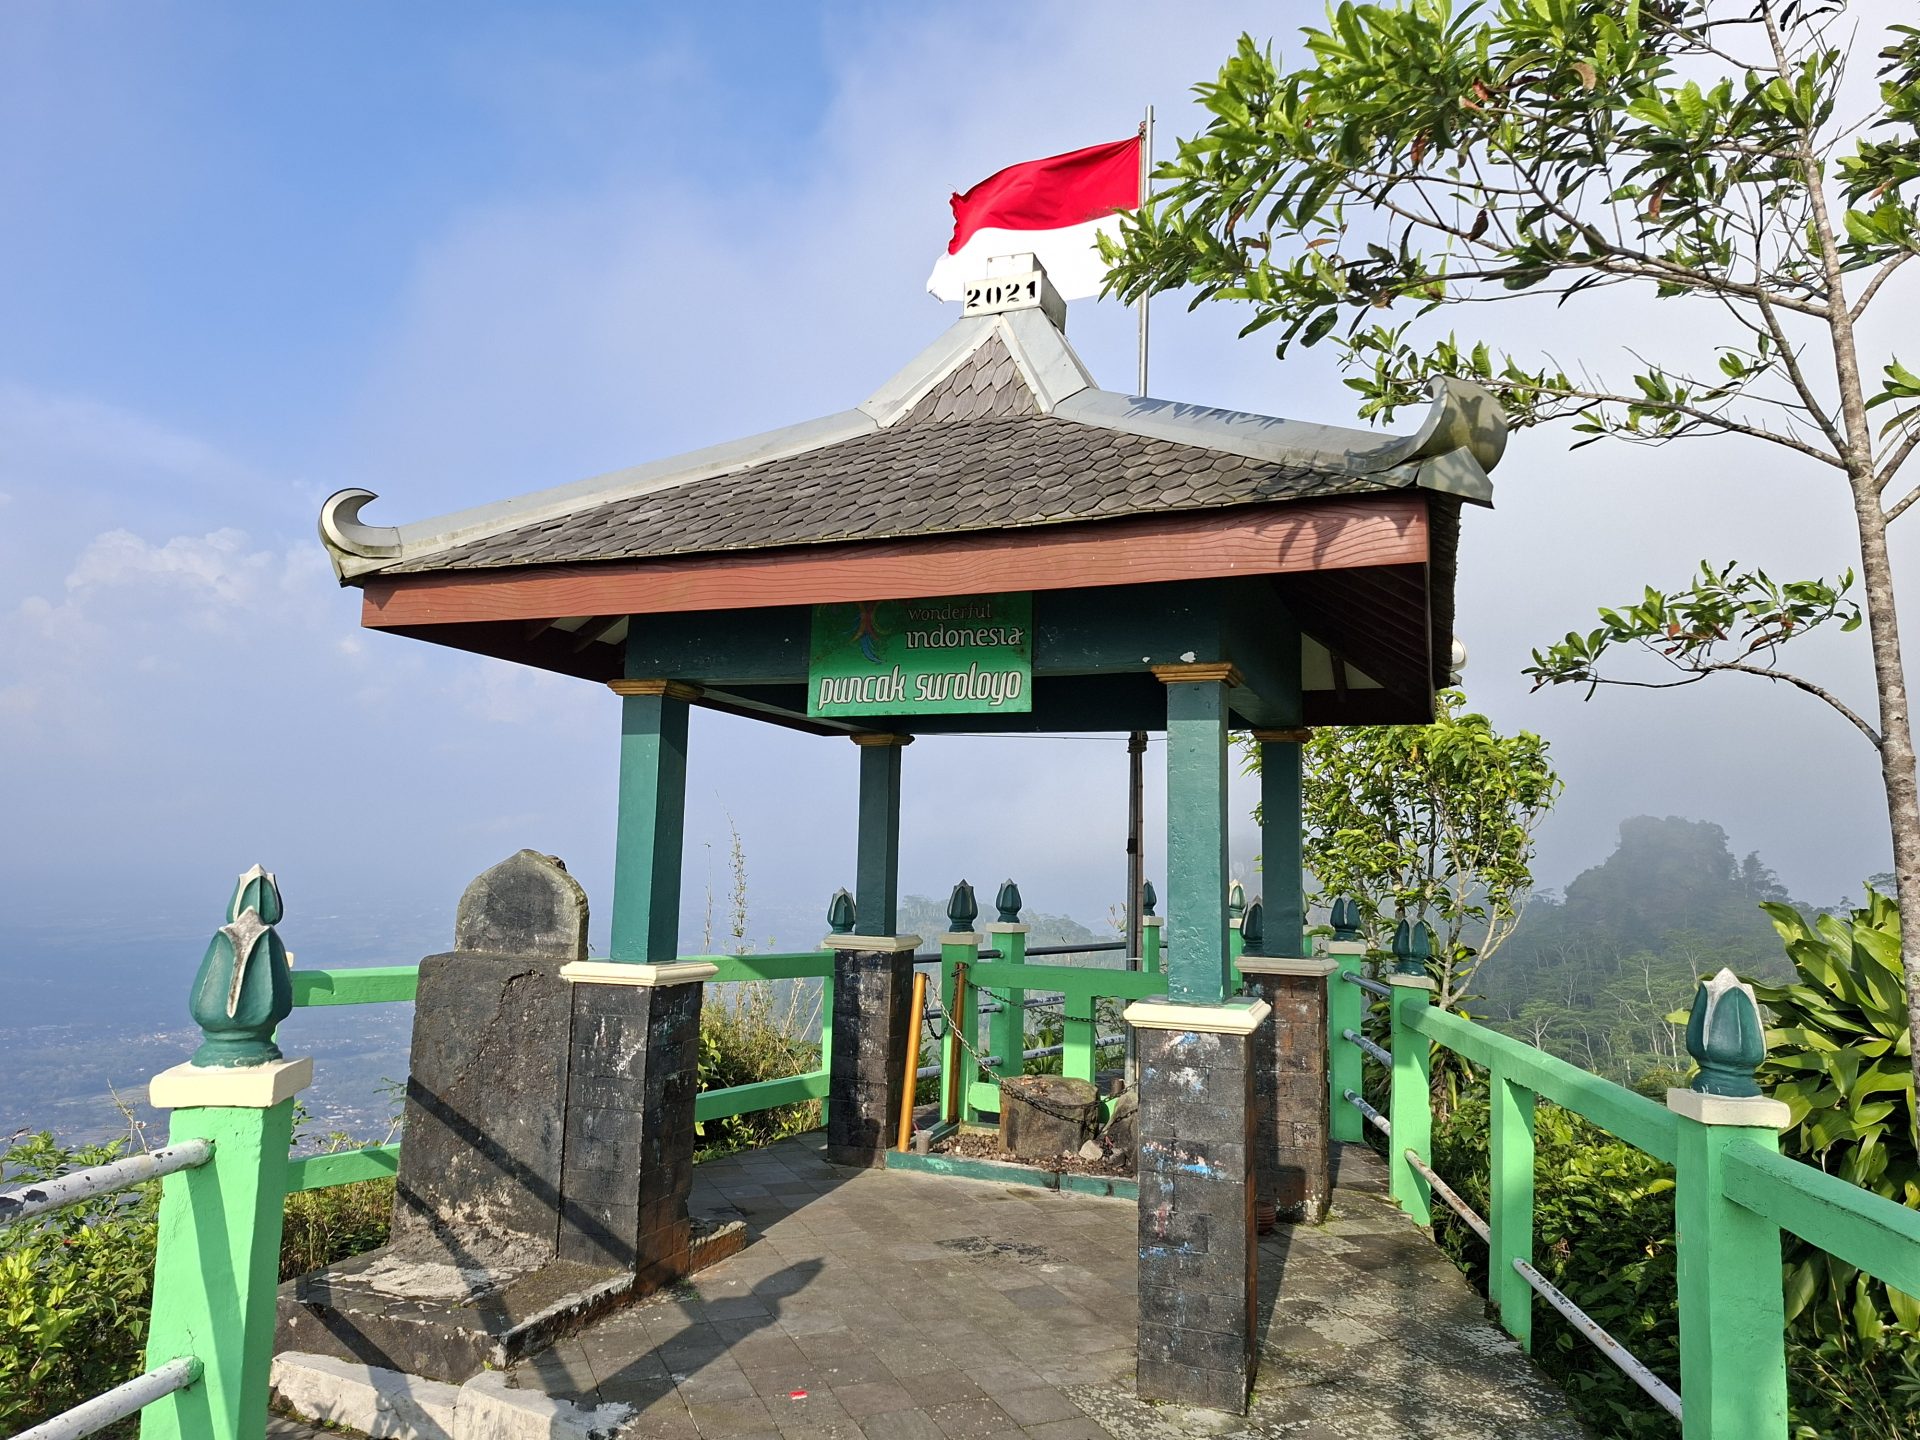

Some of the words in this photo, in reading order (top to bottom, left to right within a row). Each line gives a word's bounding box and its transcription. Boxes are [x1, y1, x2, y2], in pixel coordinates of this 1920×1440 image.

[967, 281, 1035, 308] 2021
[908, 603, 992, 621] wonderful
[905, 623, 1024, 649] indonesia
[818, 664, 906, 711] puncak
[914, 661, 1022, 707] suroloyo
